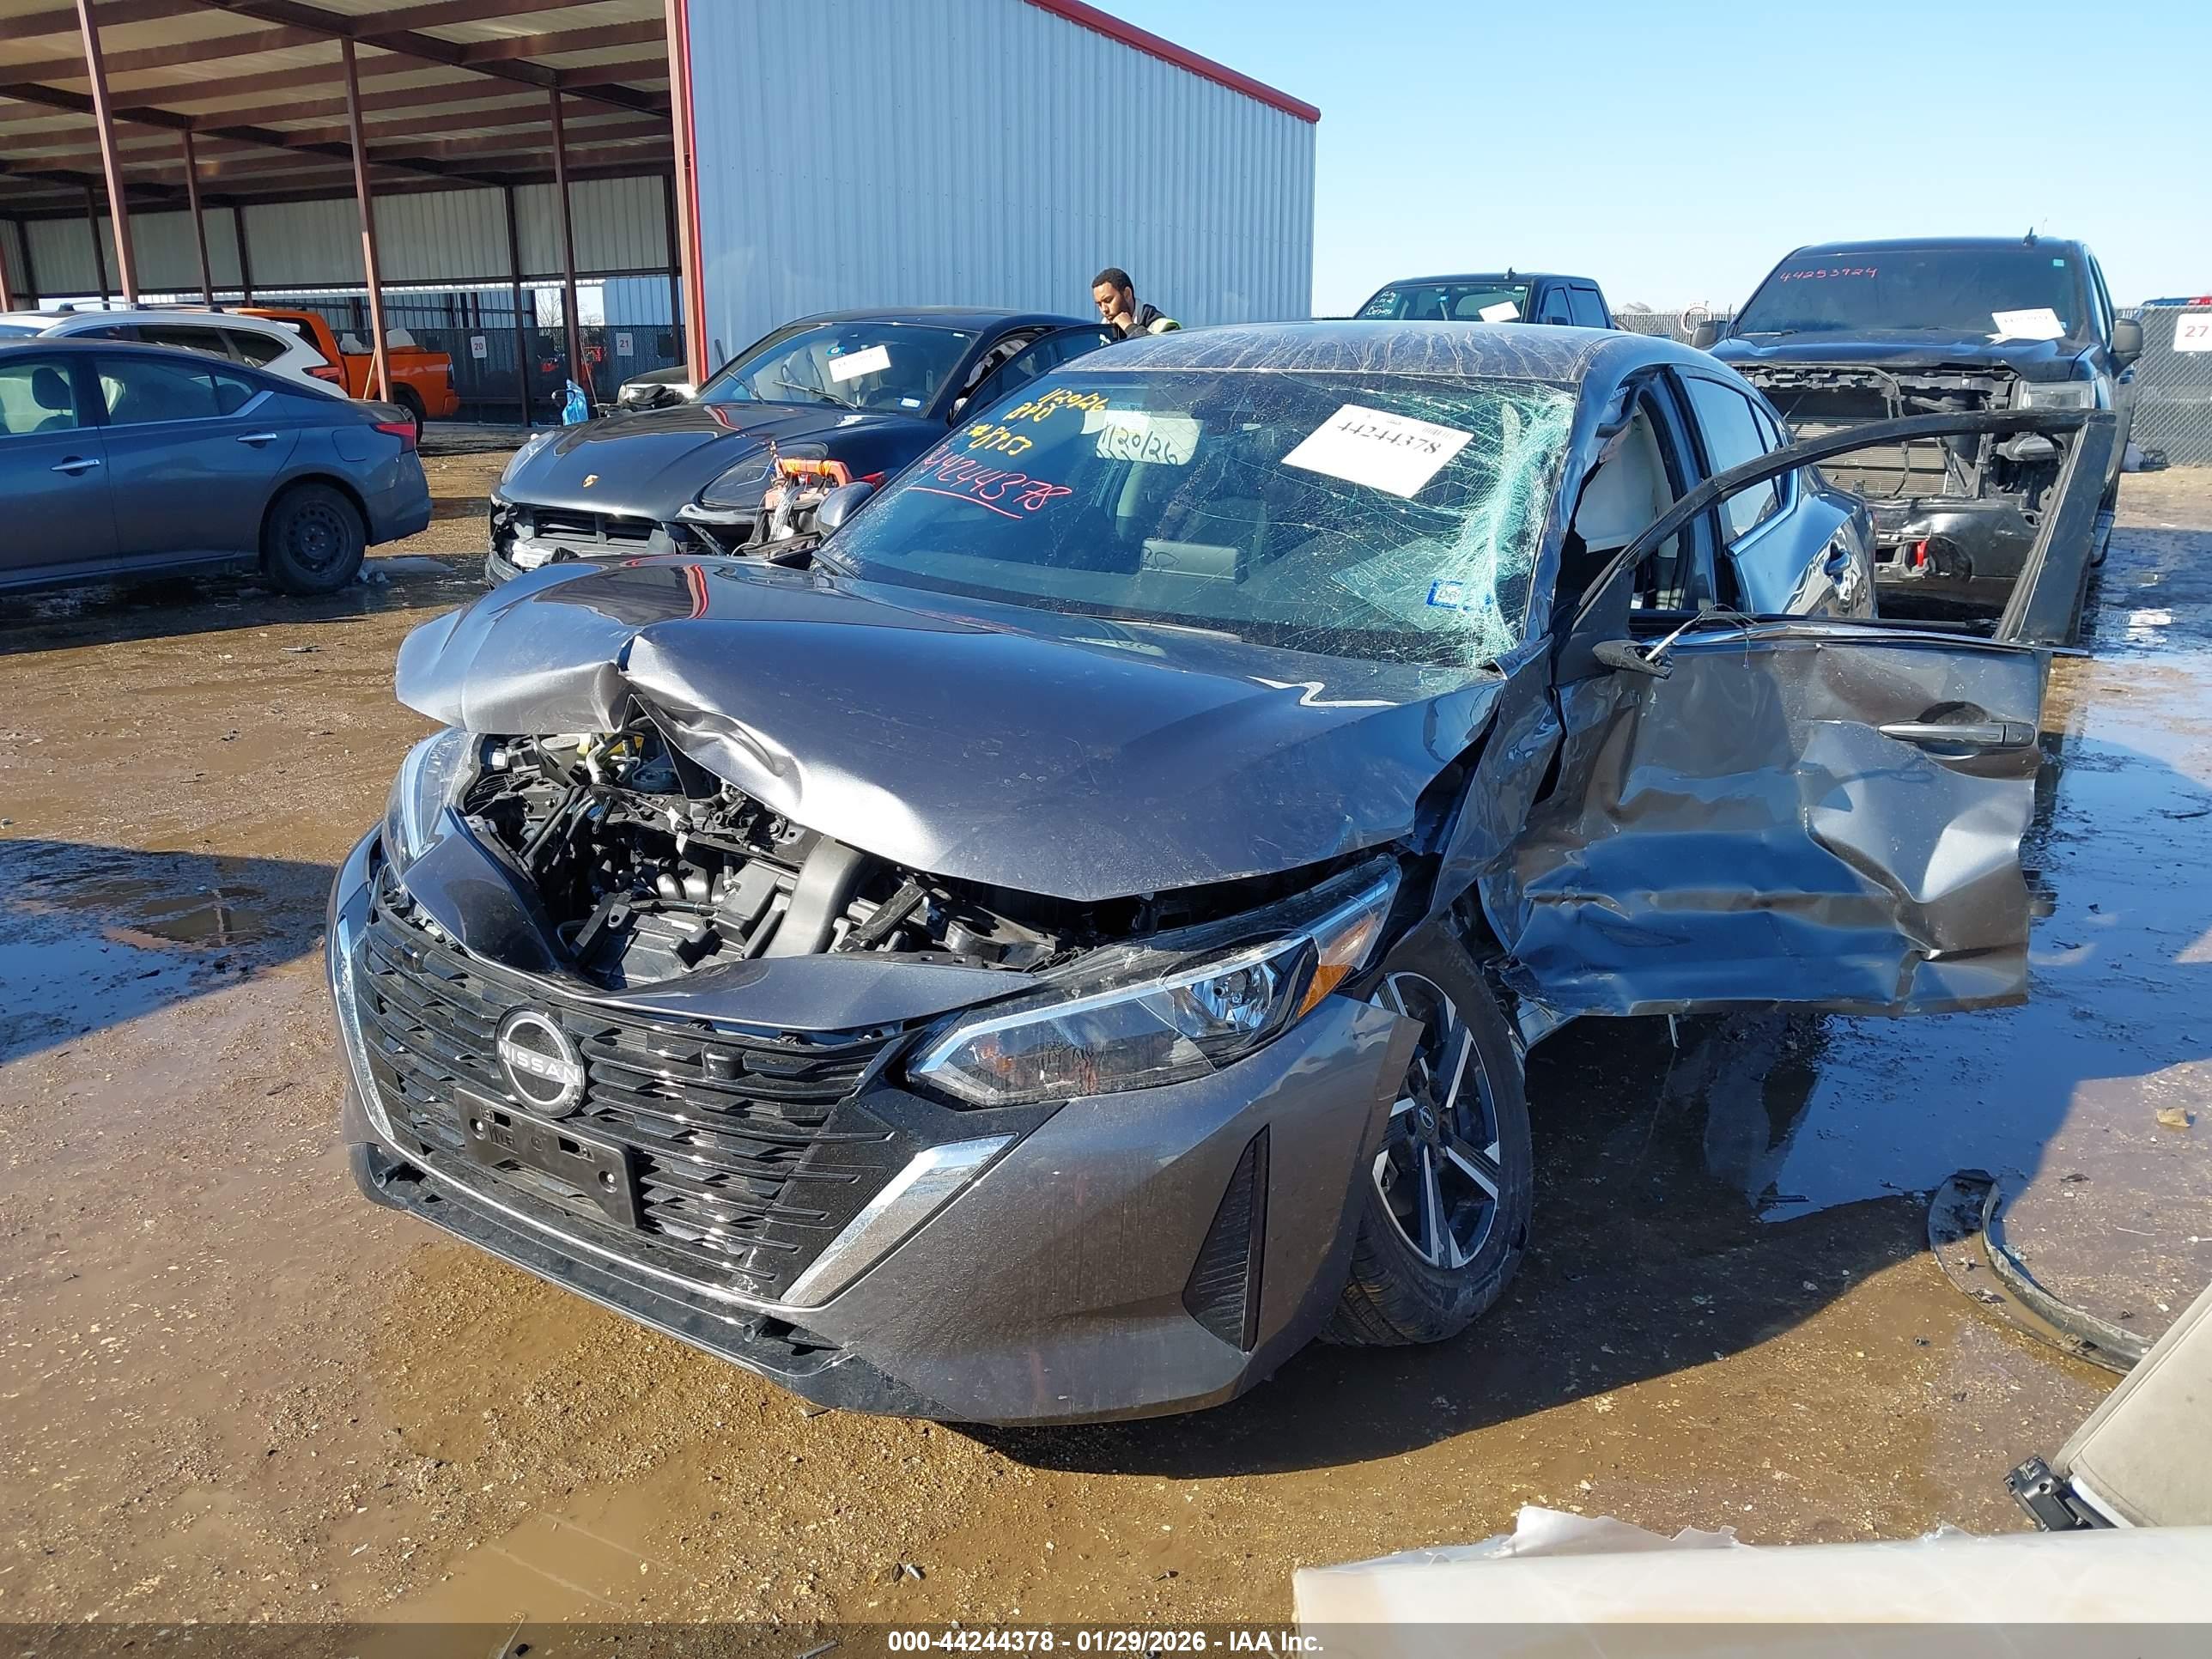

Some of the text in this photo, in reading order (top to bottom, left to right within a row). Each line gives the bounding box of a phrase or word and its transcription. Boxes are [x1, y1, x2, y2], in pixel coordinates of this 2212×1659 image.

[2185, 325, 2209, 337] 27
[474, 343, 483, 351] 20
[619, 339, 629, 349] 21
[1337, 421, 1442, 454] 44244378
[498, 1040, 579, 1082] NISSAN
